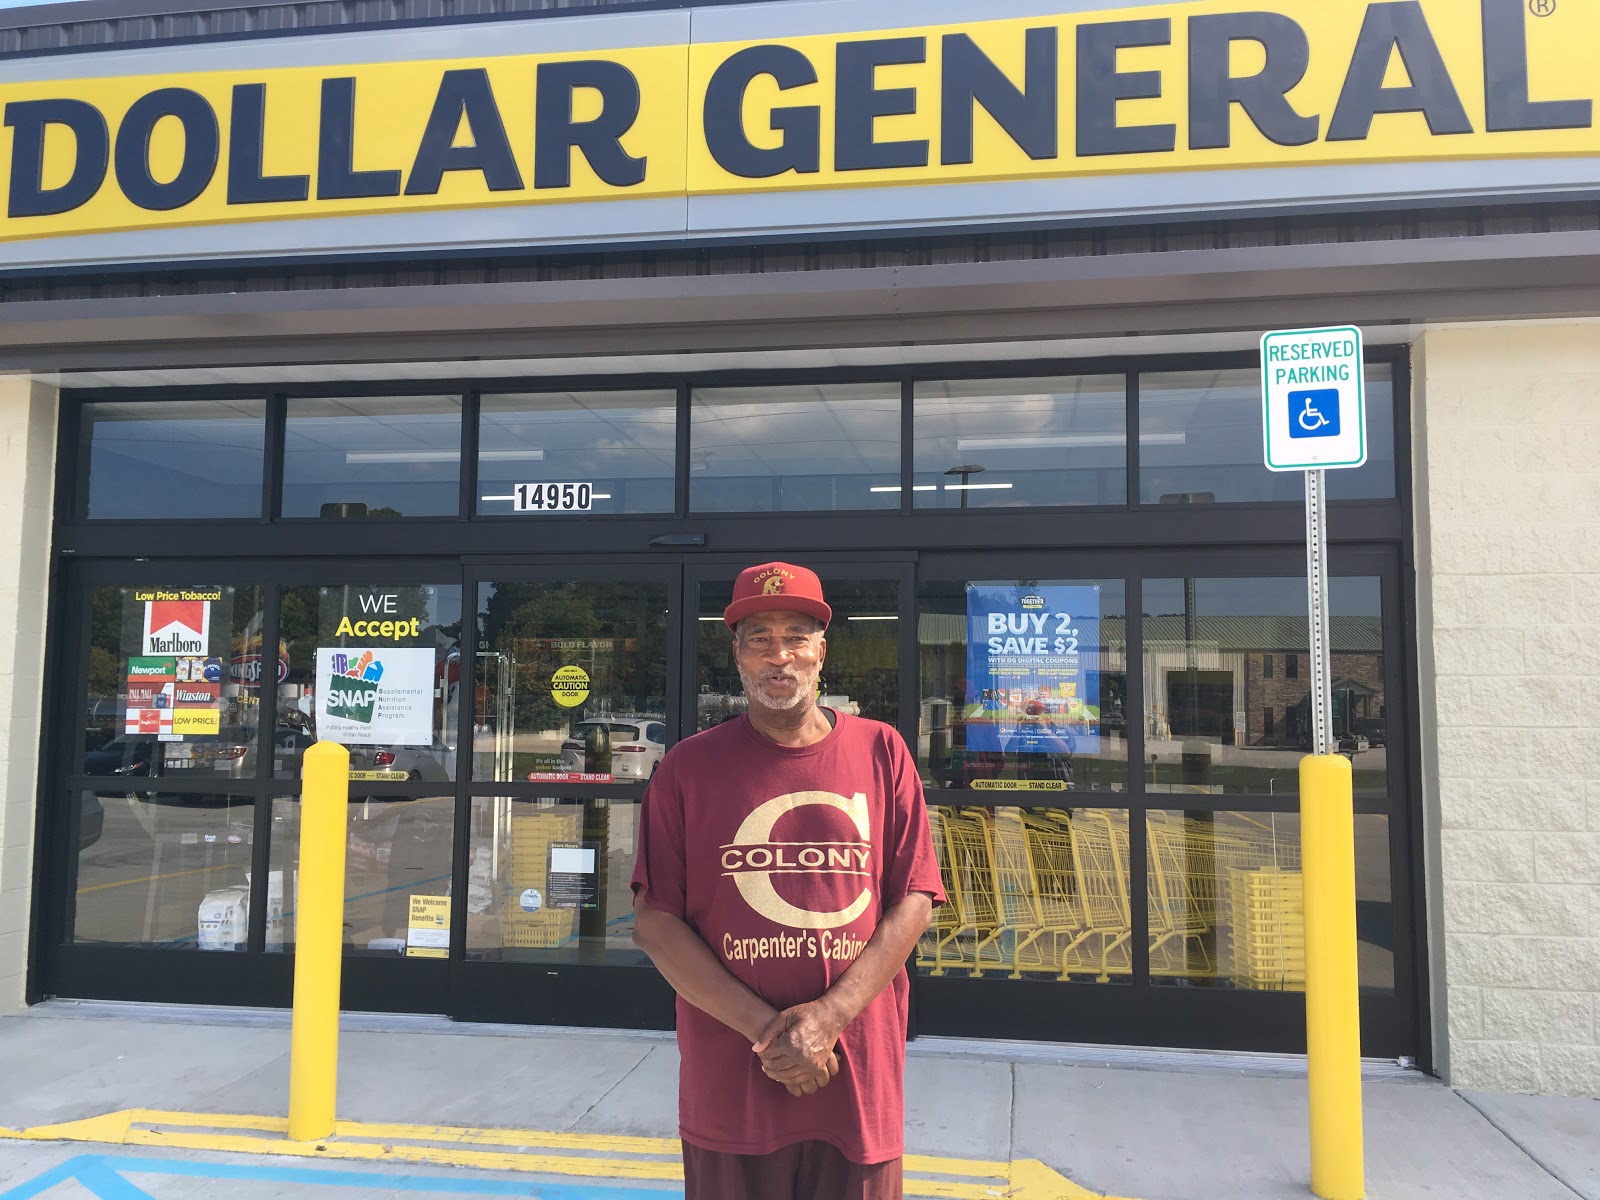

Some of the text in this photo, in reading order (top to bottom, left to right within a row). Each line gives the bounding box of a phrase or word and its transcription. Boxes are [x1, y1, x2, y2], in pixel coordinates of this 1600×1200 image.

[2, 0, 1592, 218] DOLLAR GENERAL
[1269, 340, 1354, 362] RESERVED
[1276, 364, 1349, 385] PARKING
[518, 484, 590, 509] 14950
[753, 568, 796, 584] COLONY
[135, 591, 221, 601] Low Price Tobacco!
[359, 594, 398, 613] WE
[335, 616, 420, 641] Accept
[988, 612, 1079, 637] BUY 2,
[149, 632, 202, 653] Marlboro
[551, 641, 575, 649] BOLD
[577, 641, 613, 649] FLAVOR
[988, 636, 1079, 655] SAVE $2
[131, 665, 166, 676] Newport
[553, 682, 588, 690] CAUTION
[176, 689, 211, 702] Winston
[327, 689, 377, 708] SNAP
[174, 717, 218, 725] LOW PRICE!
[391, 772, 405, 780] CLEAR
[580, 773, 594, 781] STAND
[596, 773, 610, 781] CLEAR
[975, 781, 1003, 789] AUTOMATIC
[721, 848, 870, 869] COLONY
[422, 898, 448, 906] Welcome
[411, 914, 434, 922] Benefits
[723, 930, 817, 966] Carpenter's
